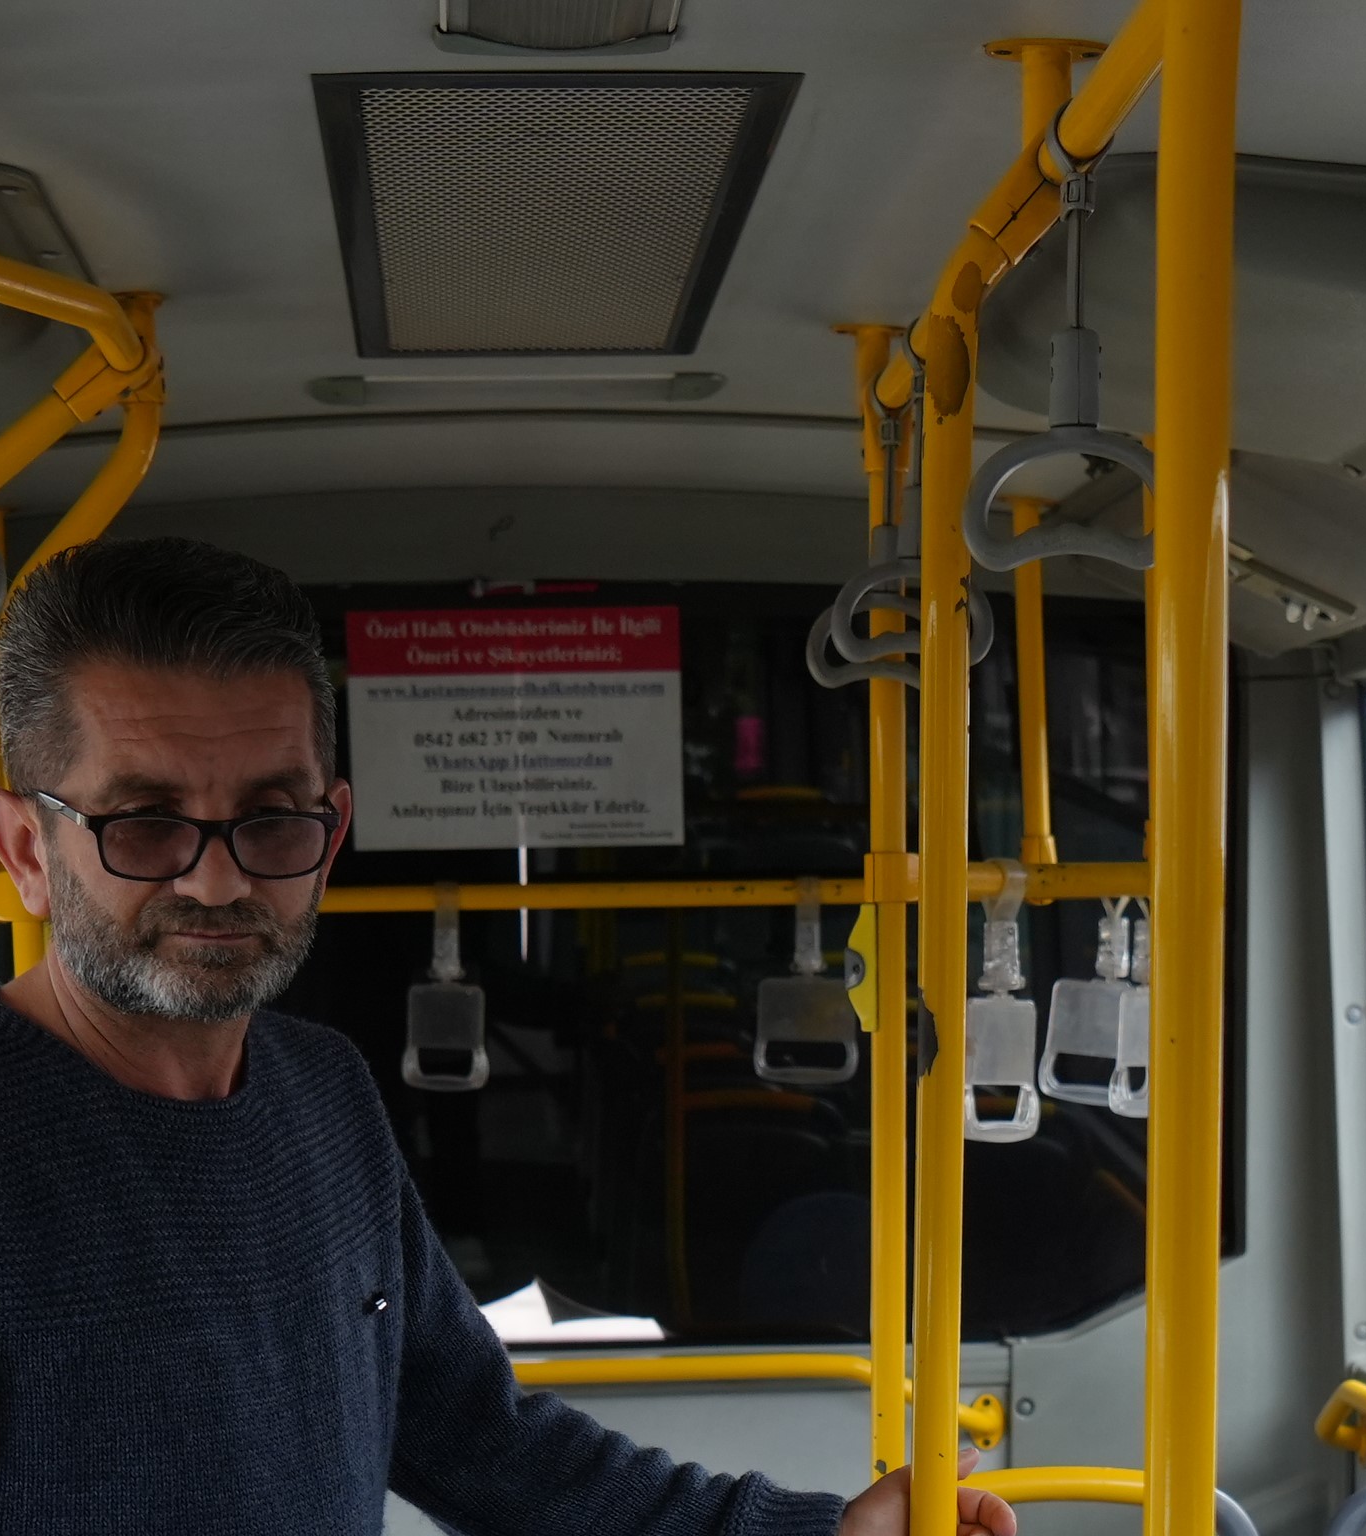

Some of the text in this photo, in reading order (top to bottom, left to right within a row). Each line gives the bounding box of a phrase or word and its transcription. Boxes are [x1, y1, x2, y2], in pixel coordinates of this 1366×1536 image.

[412, 620, 456, 638] Halk
[463, 651, 483, 664] ve
[565, 709, 583, 720] ve
